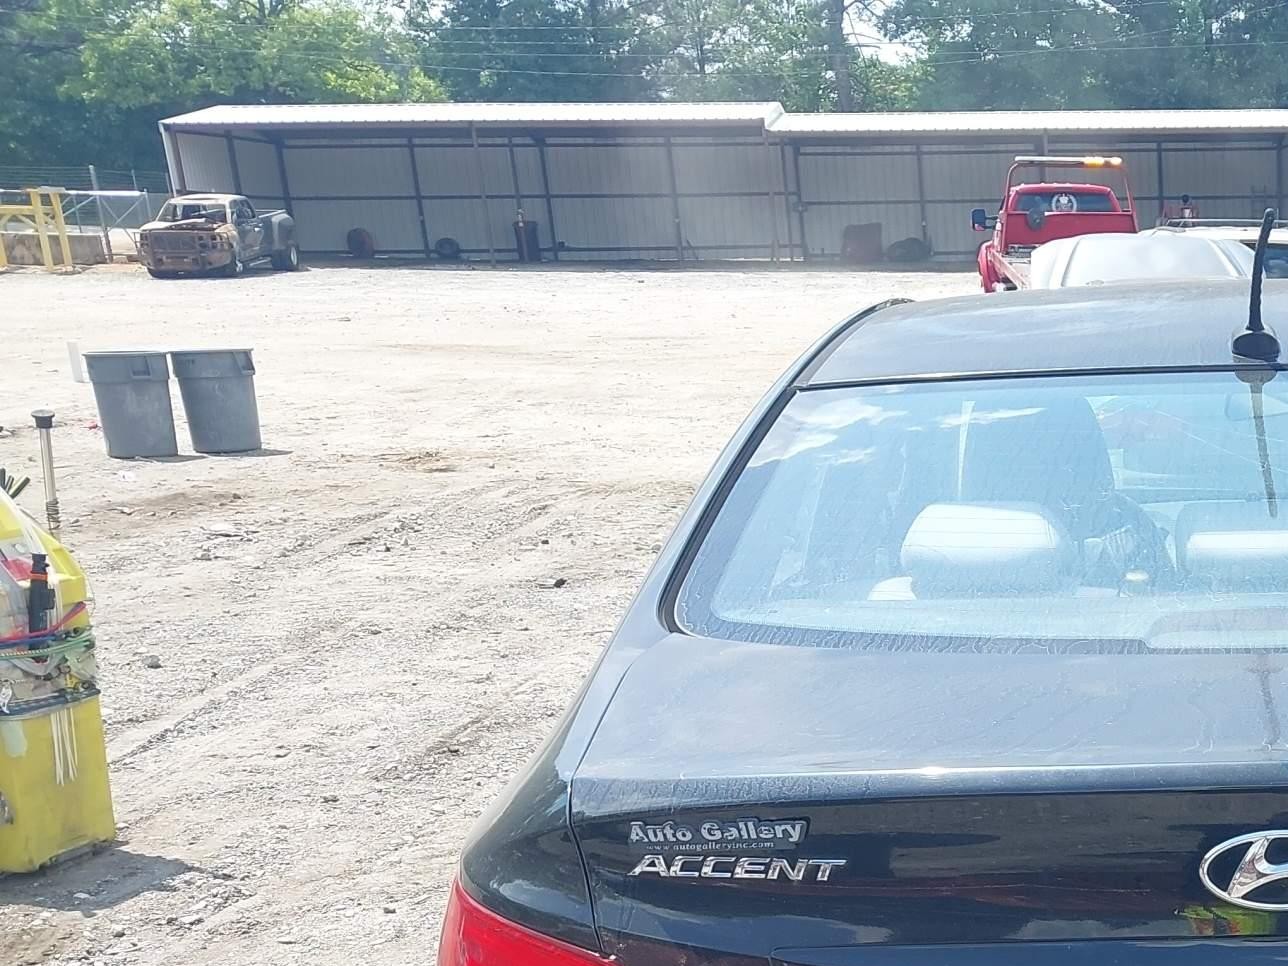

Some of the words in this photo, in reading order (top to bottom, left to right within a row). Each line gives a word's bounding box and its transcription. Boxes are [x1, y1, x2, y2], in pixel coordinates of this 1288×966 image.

[630, 821, 692, 842] Auto
[701, 821, 803, 842] Gallery
[627, 854, 847, 881] ACCENT
